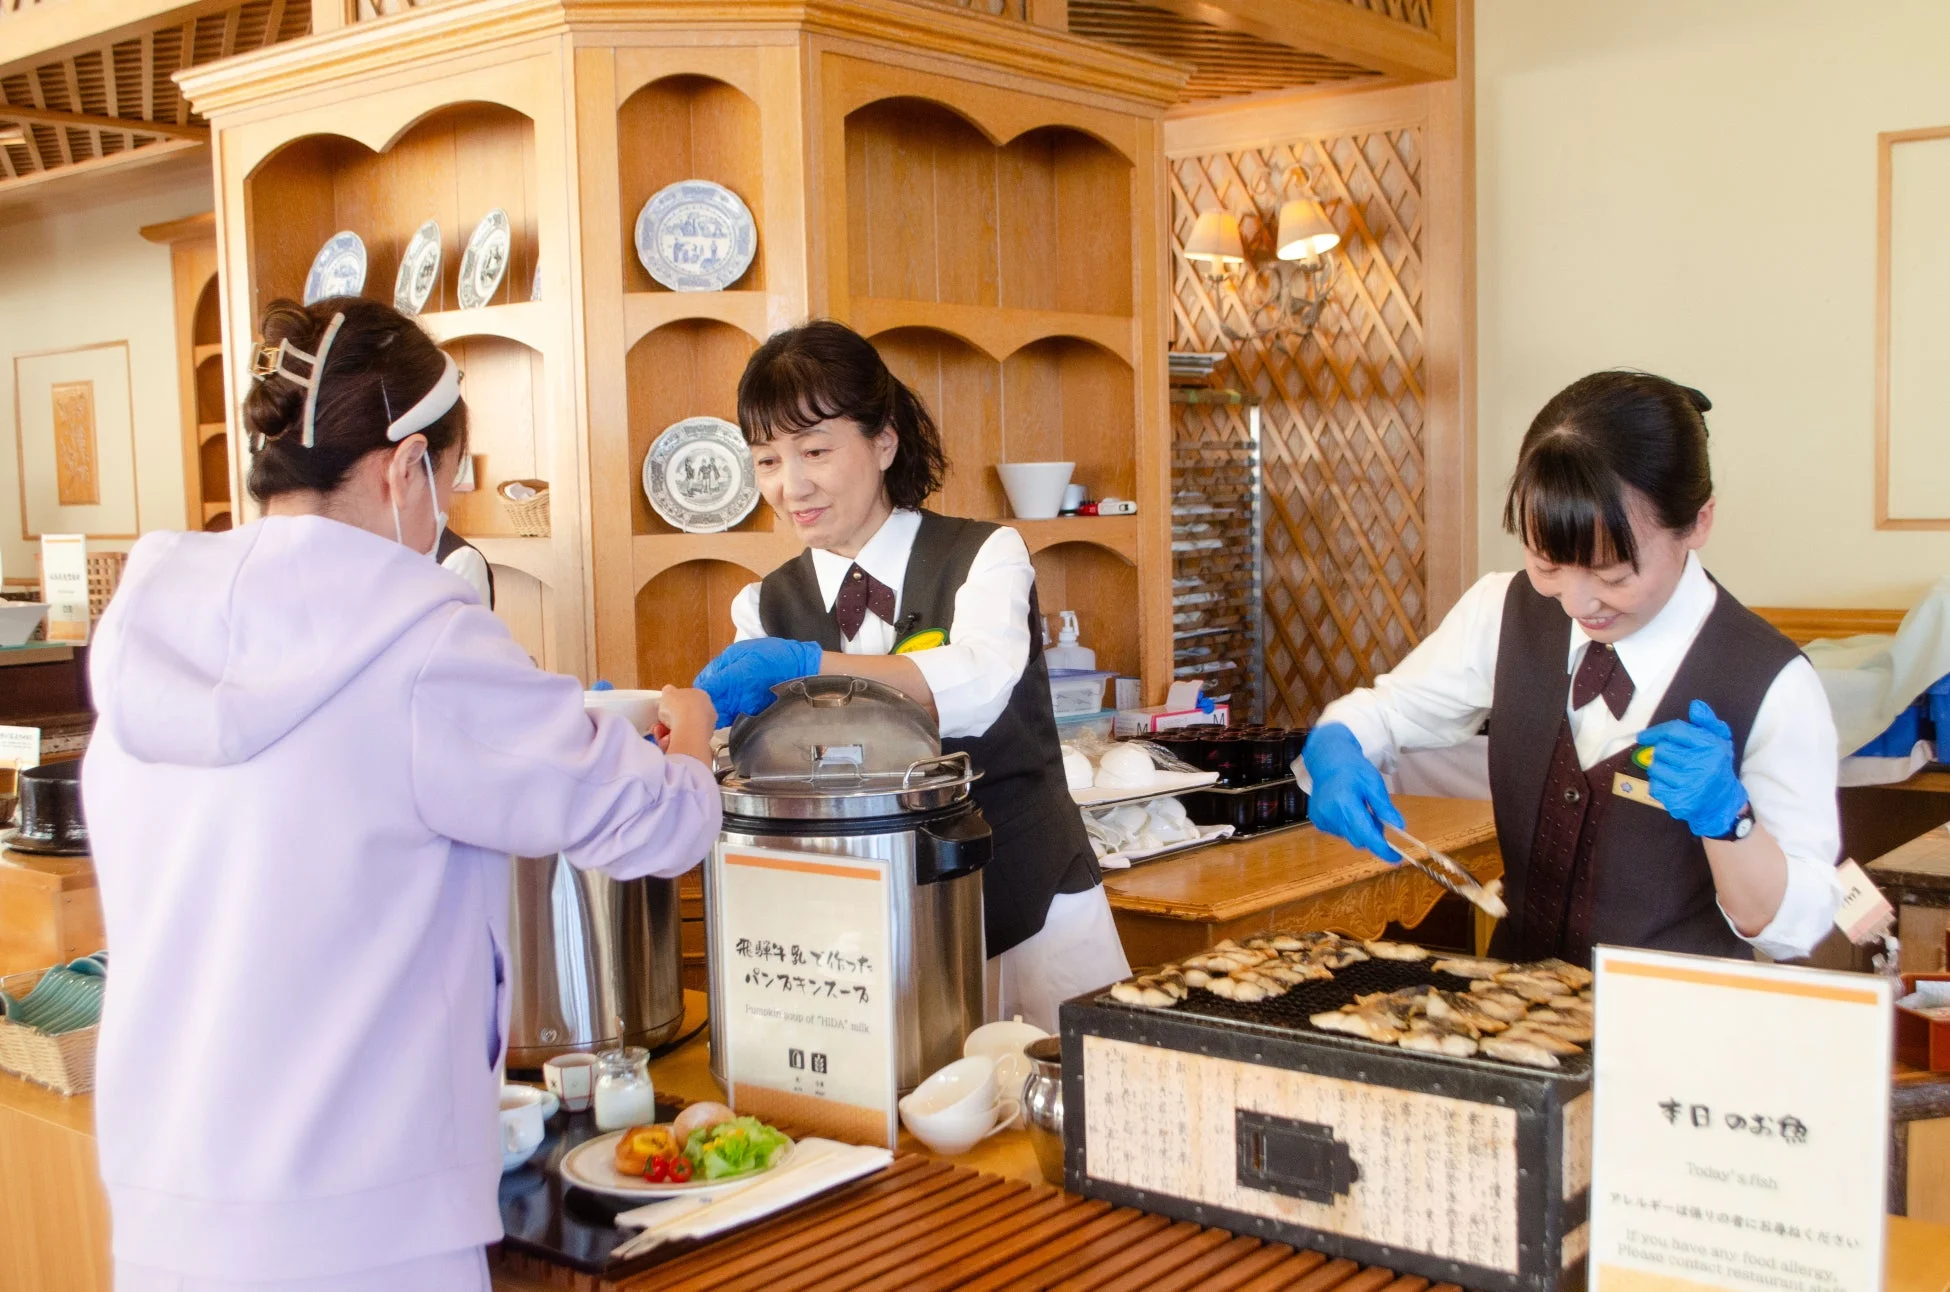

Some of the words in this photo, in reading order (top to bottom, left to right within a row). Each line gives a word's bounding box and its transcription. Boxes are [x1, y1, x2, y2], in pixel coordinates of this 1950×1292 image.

[736, 938, 872, 973] 飛騨牛乳で作った
[745, 967, 869, 1003] パンプキンスープ
[745, 1004, 781, 1020] Pumpkin
[784, 1011, 804, 1024] soup
[806, 1015, 815, 1025] of
[851, 1023, 870, 1034] milk
[1750, 1173, 1778, 1190] fish
[1618, 1242, 1664, 1263] Please
[1669, 1255, 1722, 1275] contact
[1727, 1266, 1803, 1291] restaurant
[1626, 1228, 1638, 1242] If
[1641, 1232, 1667, 1248] you
[1671, 1237, 1707, 1255] have
[1710, 1247, 1737, 1262] any
[1743, 1250, 1776, 1270] food
